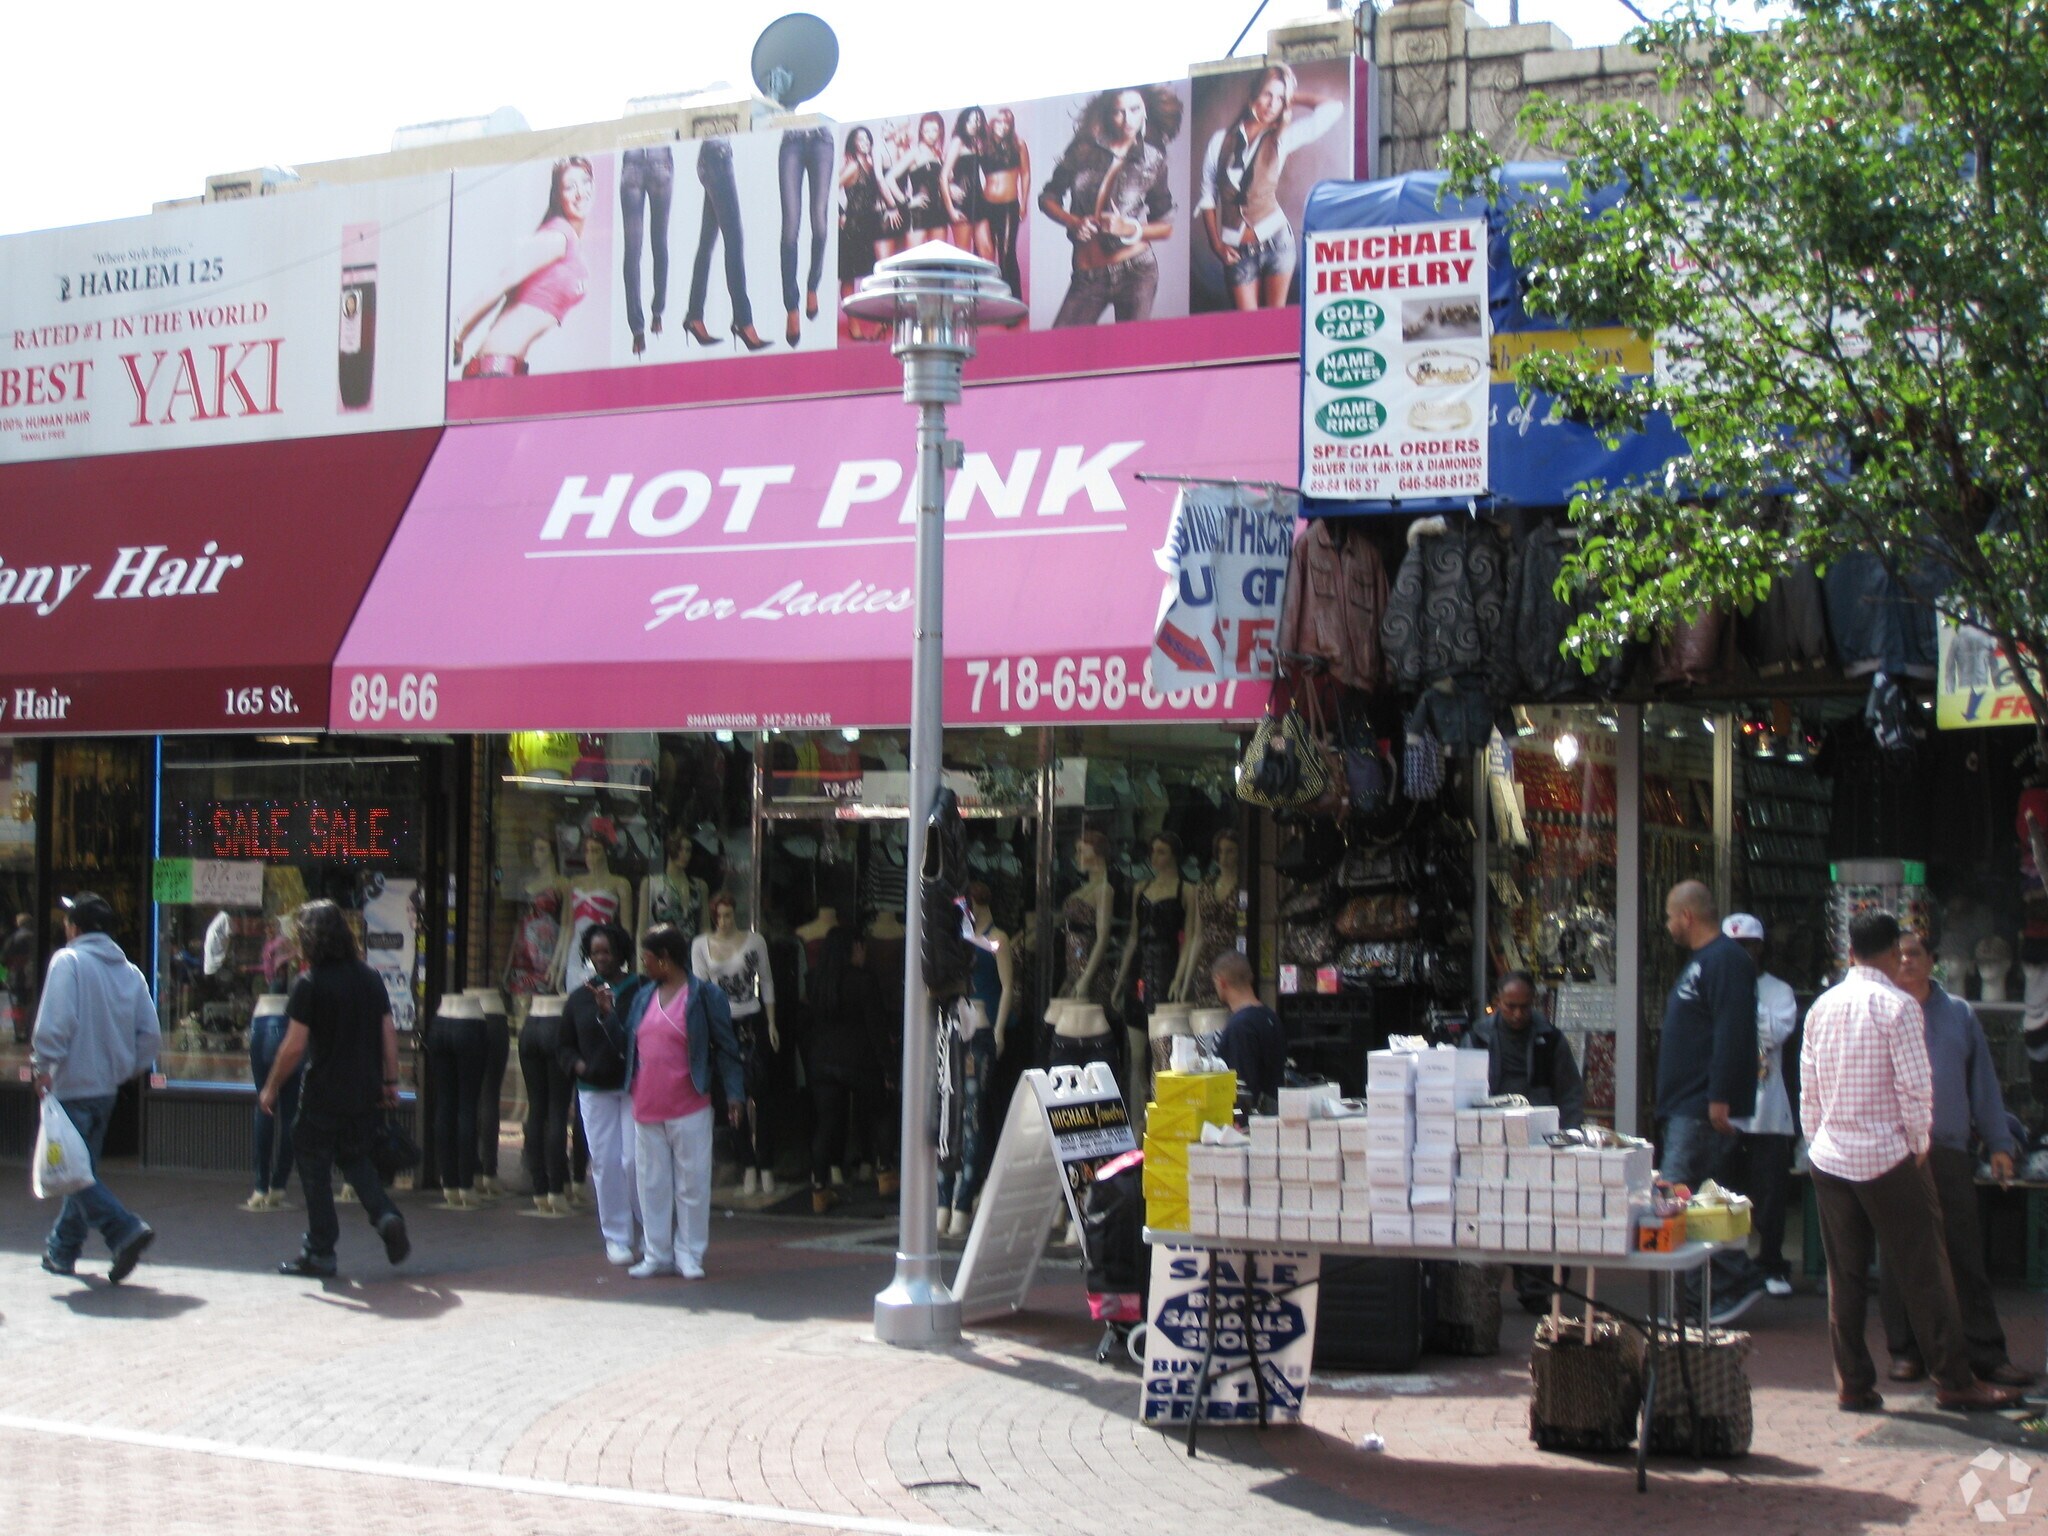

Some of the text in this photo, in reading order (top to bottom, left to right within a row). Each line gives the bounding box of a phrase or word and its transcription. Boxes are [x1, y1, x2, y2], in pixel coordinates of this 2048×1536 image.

[1315, 229, 1477, 264] MICHAEL
[80, 257, 223, 297] HARLEM 125
[1314, 258, 1474, 295] JEWELRY
[13, 302, 268, 350] RATED #1 IN THE WORLD
[1322, 303, 1378, 322] GOLD
[1322, 320, 1375, 338] CAPS
[1323, 351, 1375, 370] NAME
[1323, 367, 1381, 383] PLATES
[0, 357, 94, 408] BEST
[119, 338, 285, 427] YAKI
[25, 413, 63, 429] HUMAN
[65, 410, 90, 424] HAIR
[1328, 401, 1376, 417] NAME
[1326, 416, 1379, 433] RINGS
[1313, 439, 1480, 460] SPECIAL ORDERS
[1312, 461, 1346, 476] SILVER
[1427, 456, 1482, 472] DIAMONDS
[1365, 477, 1380, 492] ST
[539, 464, 796, 541] HOT
[93, 539, 244, 599] Hair
[644, 579, 915, 631] For Ladies
[13, 687, 72, 720] Hair
[225, 685, 300, 715] 165 St.
[350, 672, 438, 721] 89-66
[213, 808, 389, 857] SALE SALE
[1049, 1106, 1095, 1129] MICHAEL
[1170, 1259, 1298, 1287] SALE
[1152, 1358, 1204, 1374] BUY
